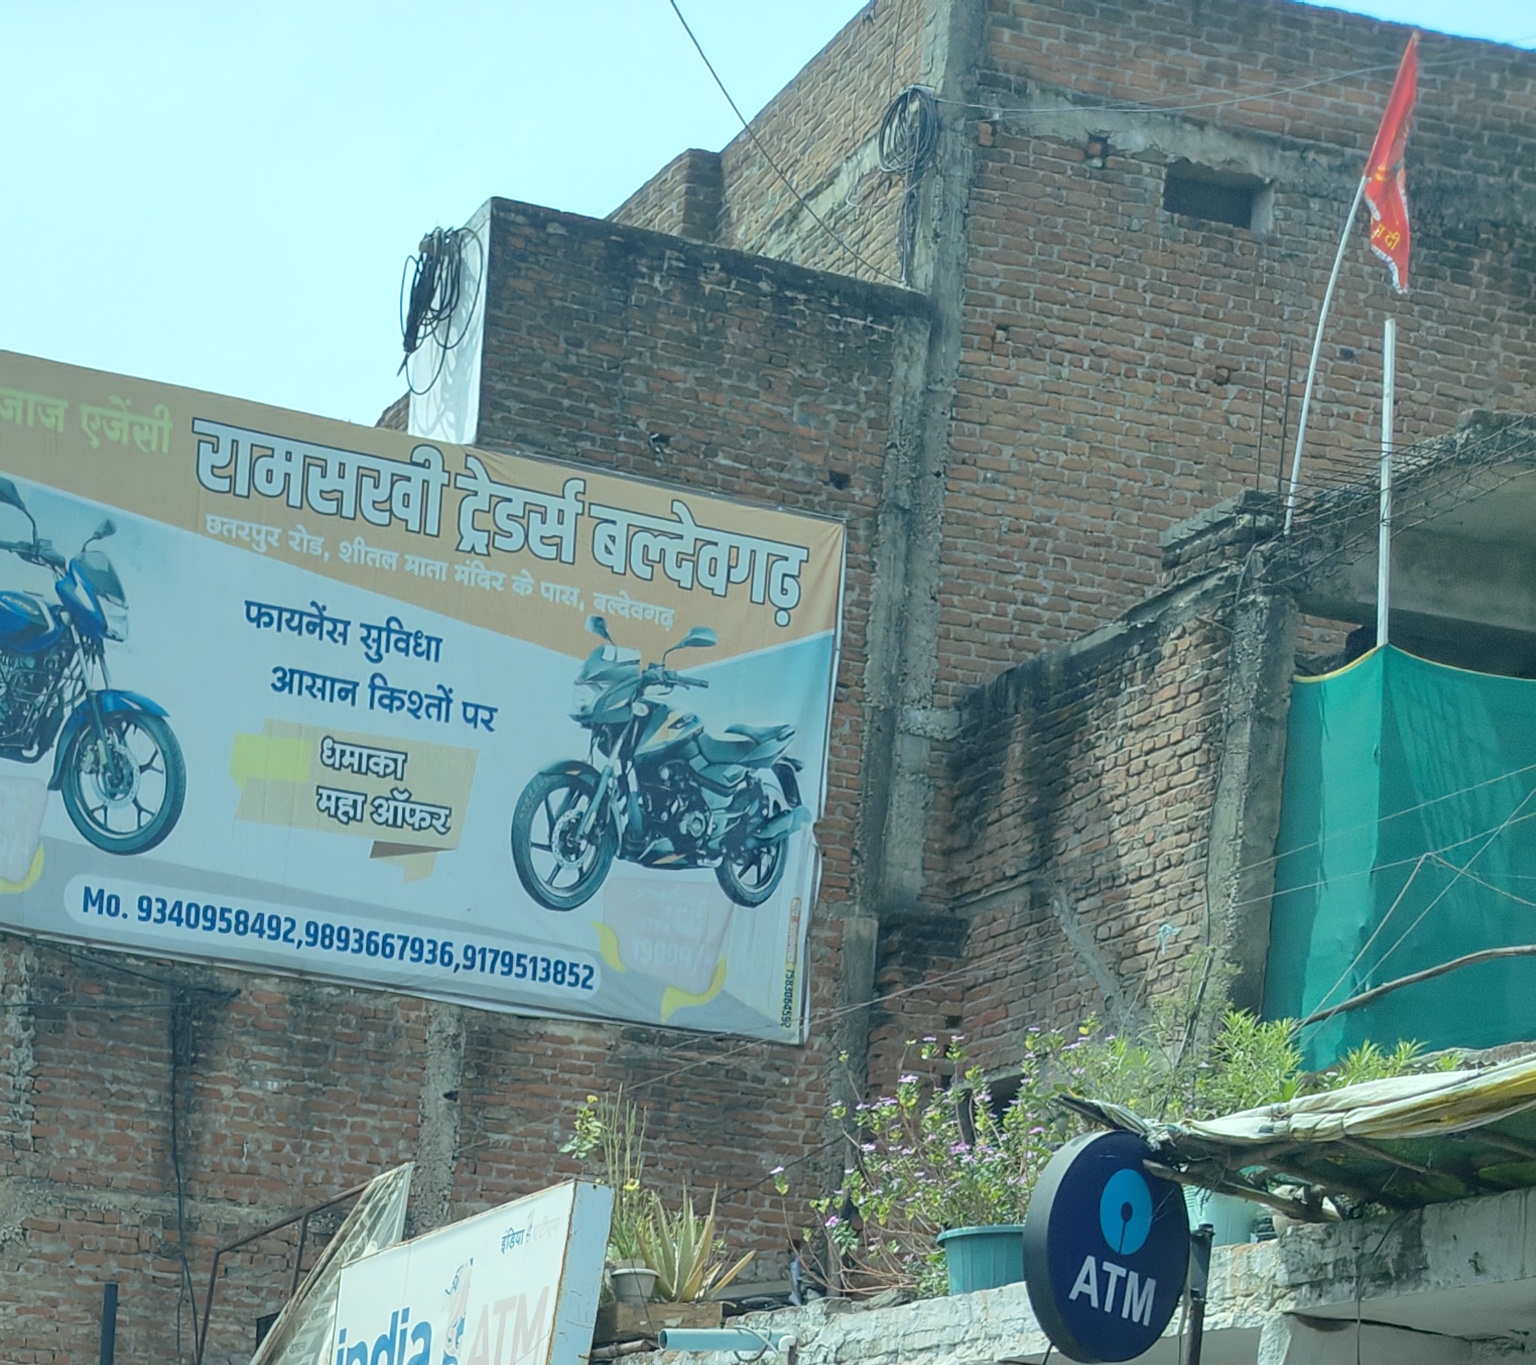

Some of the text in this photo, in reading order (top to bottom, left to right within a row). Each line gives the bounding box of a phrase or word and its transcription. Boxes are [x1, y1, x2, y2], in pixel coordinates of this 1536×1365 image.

[80, 394, 173, 454] एजेंसी
[192, 417, 809, 628] रामसखी ट्रेडर्स बल्देवगढ़
[205, 513, 281, 552] छतरपुर
[288, 524, 330, 562] रोड,
[339, 536, 399, 571] शीतल
[405, 553, 448, 582] माता
[454, 560, 506, 592] मंदिर
[511, 569, 534, 596] के
[244, 600, 443, 664] फायनेंस सुविधा
[271, 666, 498, 732] आसान किश्तों पर
[320, 736, 408, 780] धमाका
[316, 785, 451, 835] महा ऑफर
[82, 886, 128, 921] Mo.
[501, 1227, 525, 1254] इंडिया
[1069, 1255, 1157, 1327] ATM
